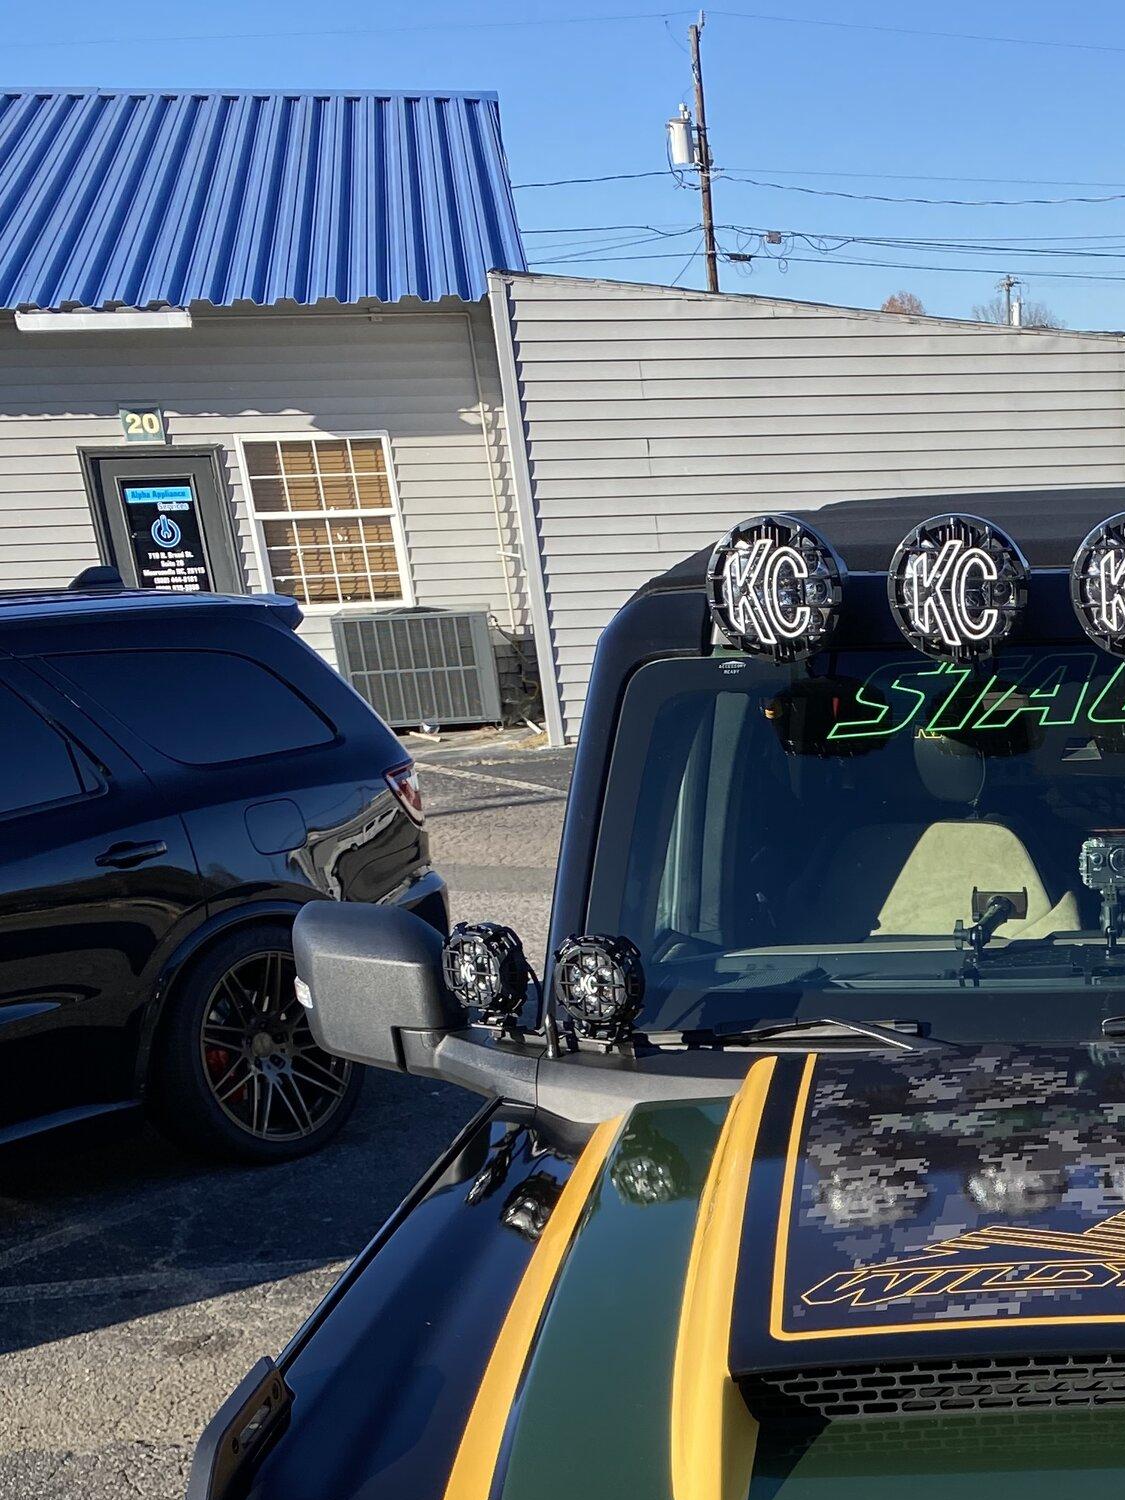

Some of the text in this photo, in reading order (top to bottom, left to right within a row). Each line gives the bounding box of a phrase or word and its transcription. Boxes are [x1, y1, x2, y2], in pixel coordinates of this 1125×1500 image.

[126, 413, 159, 433] 20
[131, 490, 186, 500] Alpha Appliance
[724, 539, 810, 645] KC
[912, 540, 998, 645] KC
[460, 962, 476, 983] KC
[580, 975, 598, 995] KC
